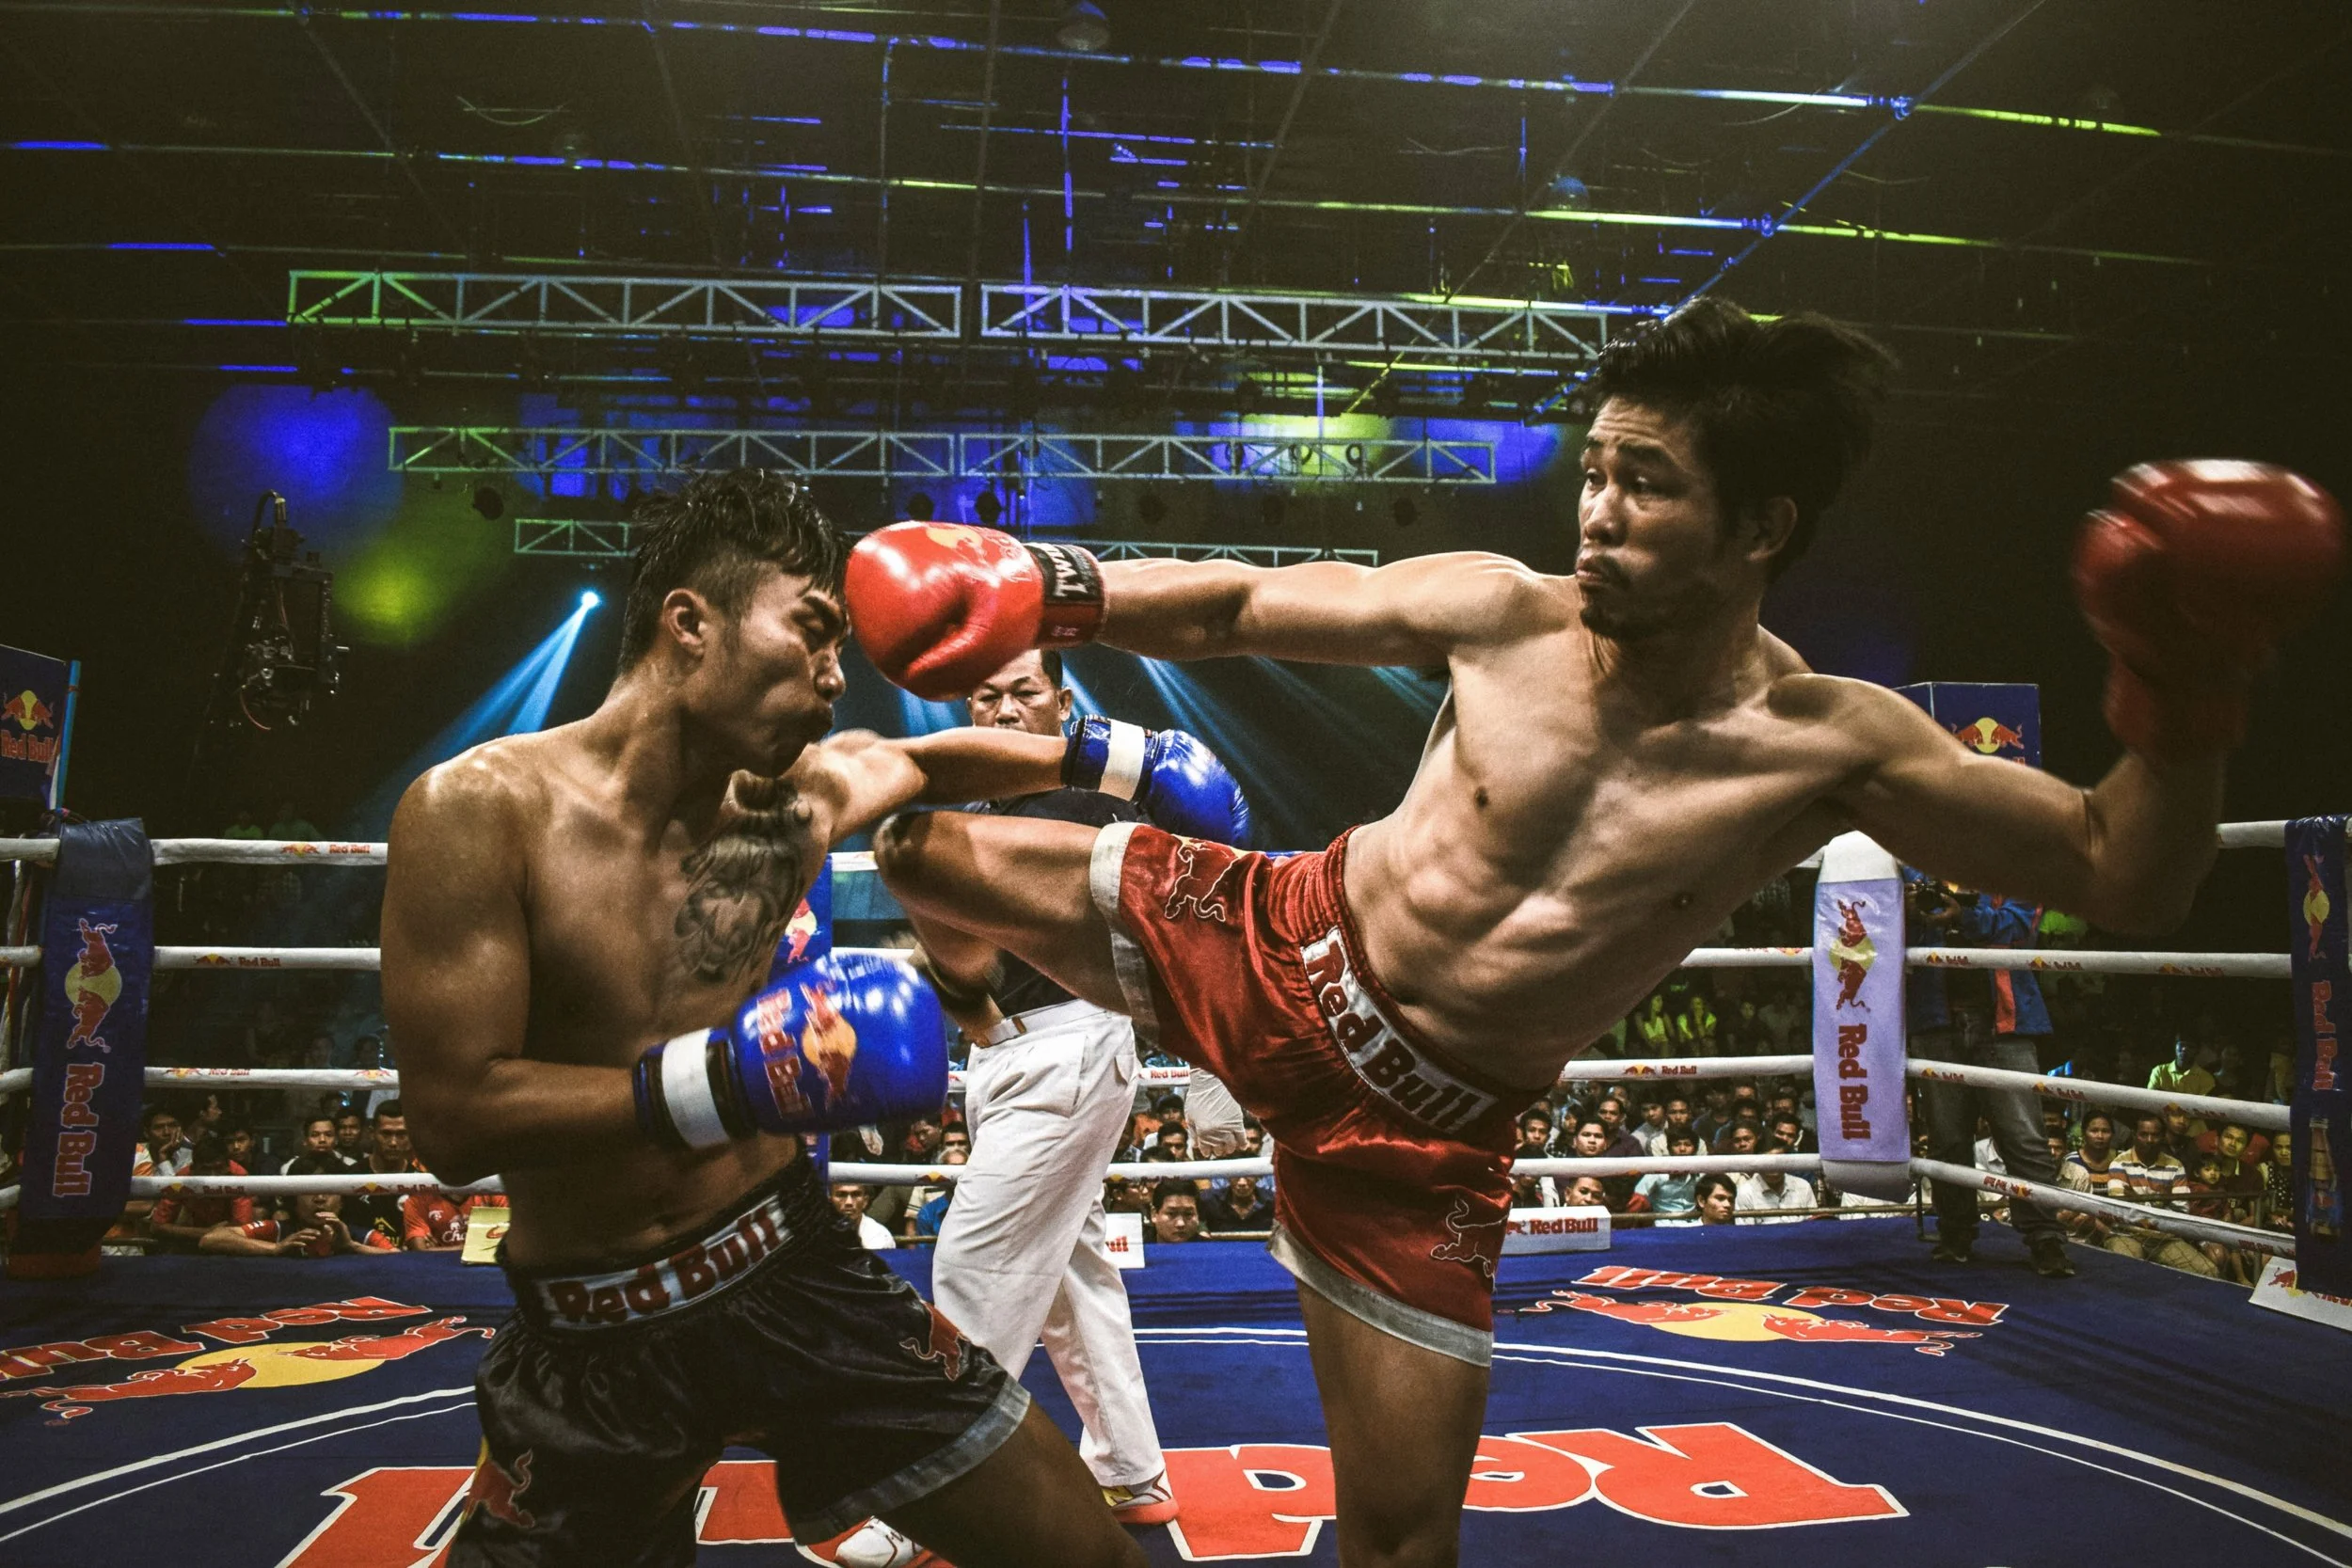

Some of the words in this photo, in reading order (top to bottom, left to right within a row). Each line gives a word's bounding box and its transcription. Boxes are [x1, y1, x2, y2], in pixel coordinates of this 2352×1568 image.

[1, 729, 26, 760] Red
[28, 734, 54, 763] Bull
[2311, 979, 2336, 1035] Red
[1306, 939, 1388, 1054] Red
[1359, 1037, 1490, 1132] Bull
[1837, 1023, 1867, 1080] Red
[1151, 1069, 1168, 1079] Red
[1661, 1065, 1678, 1075] Red
[1679, 1065, 1697, 1075] Bull
[2312, 1037, 2338, 1091] Bull
[60, 1061, 105, 1129] Red
[1839, 1084, 1871, 1140] Bull
[53, 1130, 97, 1198] Bull
[1104, 1235, 1129, 1252] ull
[1530, 1217, 1564, 1235] Red
[1564, 1217, 1598, 1234] Bull
[548, 1263, 671, 1323] Red
[667, 1207, 783, 1303] Bull
[1570, 1266, 1788, 1301] Bull
[181, 1295, 433, 1343] Red
[1782, 1286, 2010, 1325] Red
[0, 1330, 206, 1382] Bul
[1163, 1422, 1910, 1561] Red
